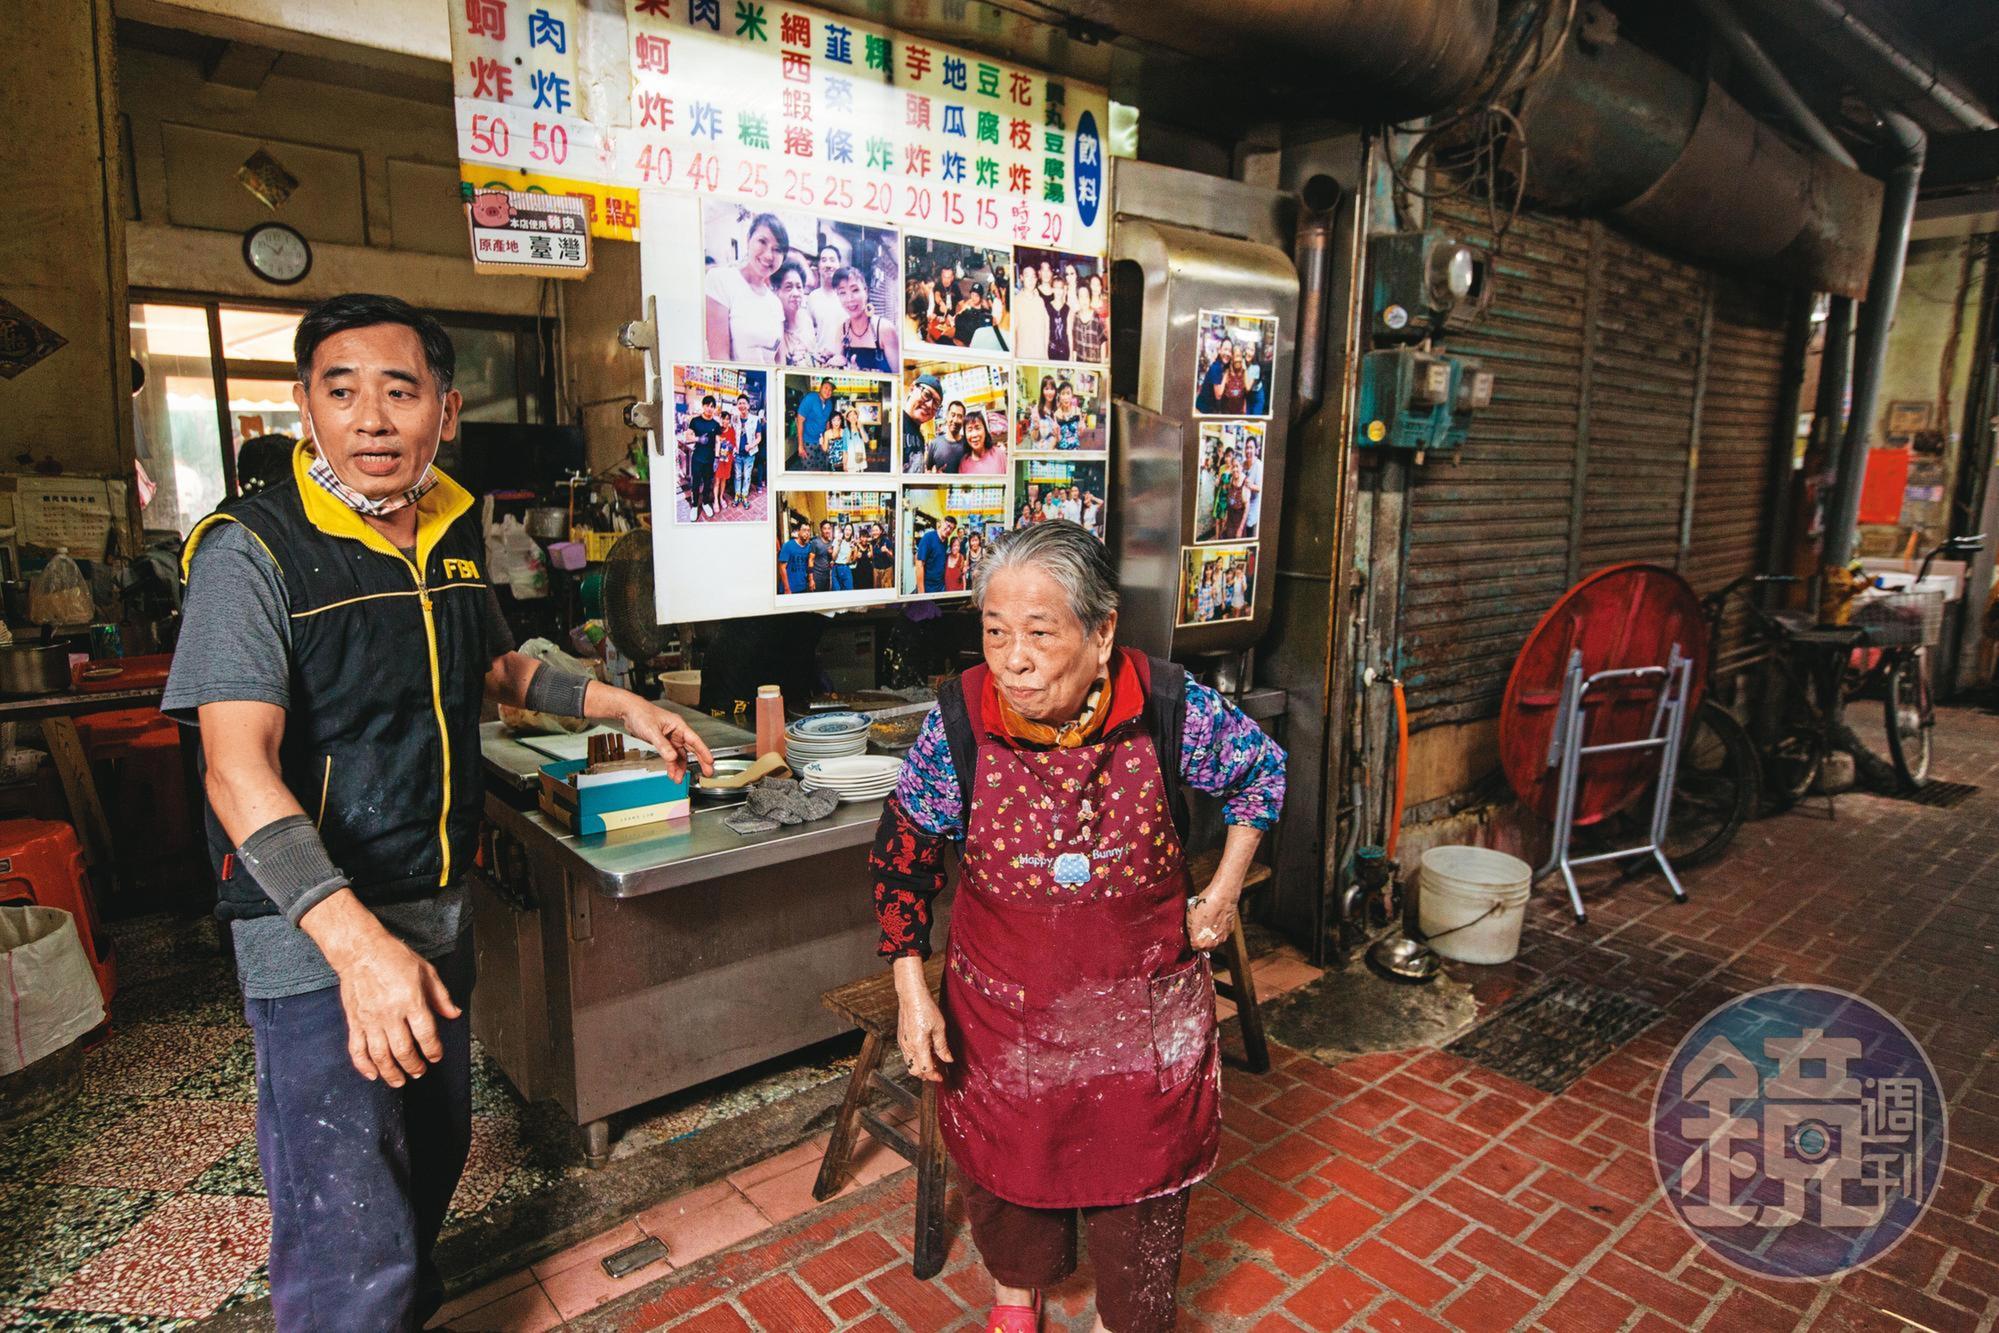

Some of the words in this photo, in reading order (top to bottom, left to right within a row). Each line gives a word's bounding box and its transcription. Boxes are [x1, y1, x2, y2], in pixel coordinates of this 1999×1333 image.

[528, 8, 571, 114] 肉炸
[734, 0, 770, 150] 米糕
[904, 44, 932, 179] 芋頭炸
[941, 55, 967, 185] 地瓜炸
[975, 62, 1001, 190] 豆腐炸
[470, 113, 509, 158] 50
[529, 121, 568, 165] 50
[1008, 72, 1032, 196] 花枝炸
[635, 143, 673, 186] 40
[687, 152, 720, 192] 40
[737, 159, 769, 199] 25
[1078, 132, 1098, 208] 飲料
[784, 168, 815, 206] 25
[823, 175, 853, 210] 25
[863, 181, 893, 215] 20
[904, 186, 931, 220] 20
[942, 190, 965, 225] 15
[977, 198, 999, 230] 15
[1041, 211, 1062, 242] 20
[479, 238, 519, 253] 原產地
[529, 235, 580, 261] 臺灣
[443, 558, 480, 579] FBI
[1020, 853, 1054, 868] Happy
[1092, 846, 1124, 860] Bunny
